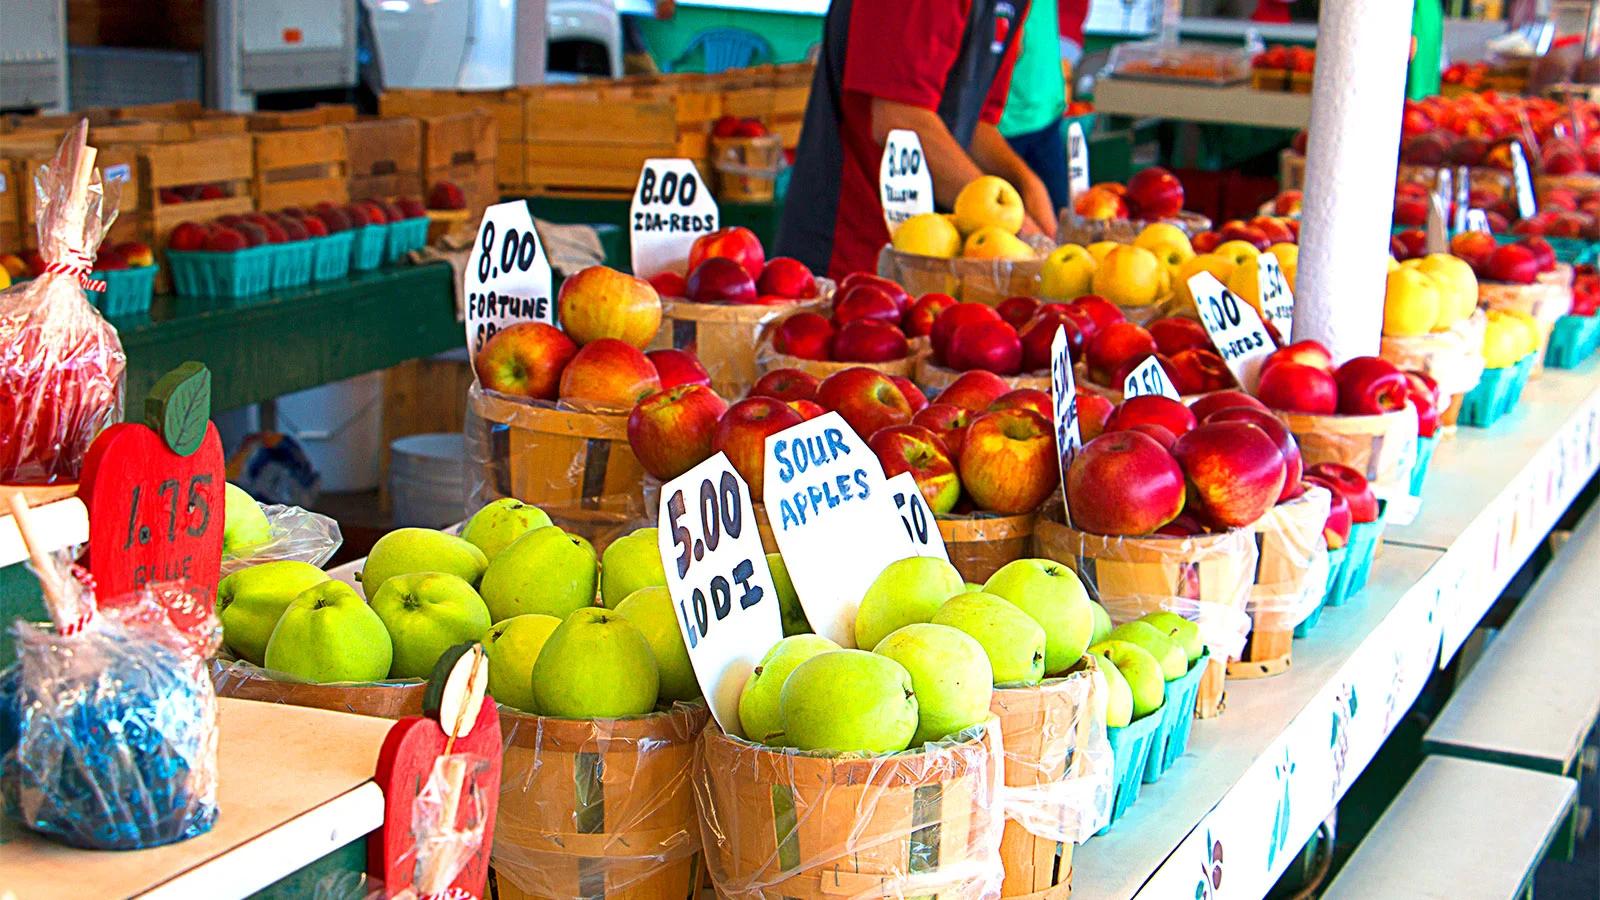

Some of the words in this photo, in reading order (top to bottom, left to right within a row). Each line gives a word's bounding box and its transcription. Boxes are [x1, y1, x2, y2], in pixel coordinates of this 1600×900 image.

[640, 167, 697, 206] 8.00
[888, 142, 920, 177] 8.00
[634, 212, 714, 232] IDA-REDS
[478, 220, 536, 284] 8.00
[469, 291, 548, 321] FORTUNE
[774, 428, 851, 483] SOUR
[123, 473, 213, 550] 1.75
[667, 470, 742, 580] 5.00
[779, 468, 872, 531] APPLES
[133, 556, 193, 598] BLUE
[680, 558, 764, 649] LODI
